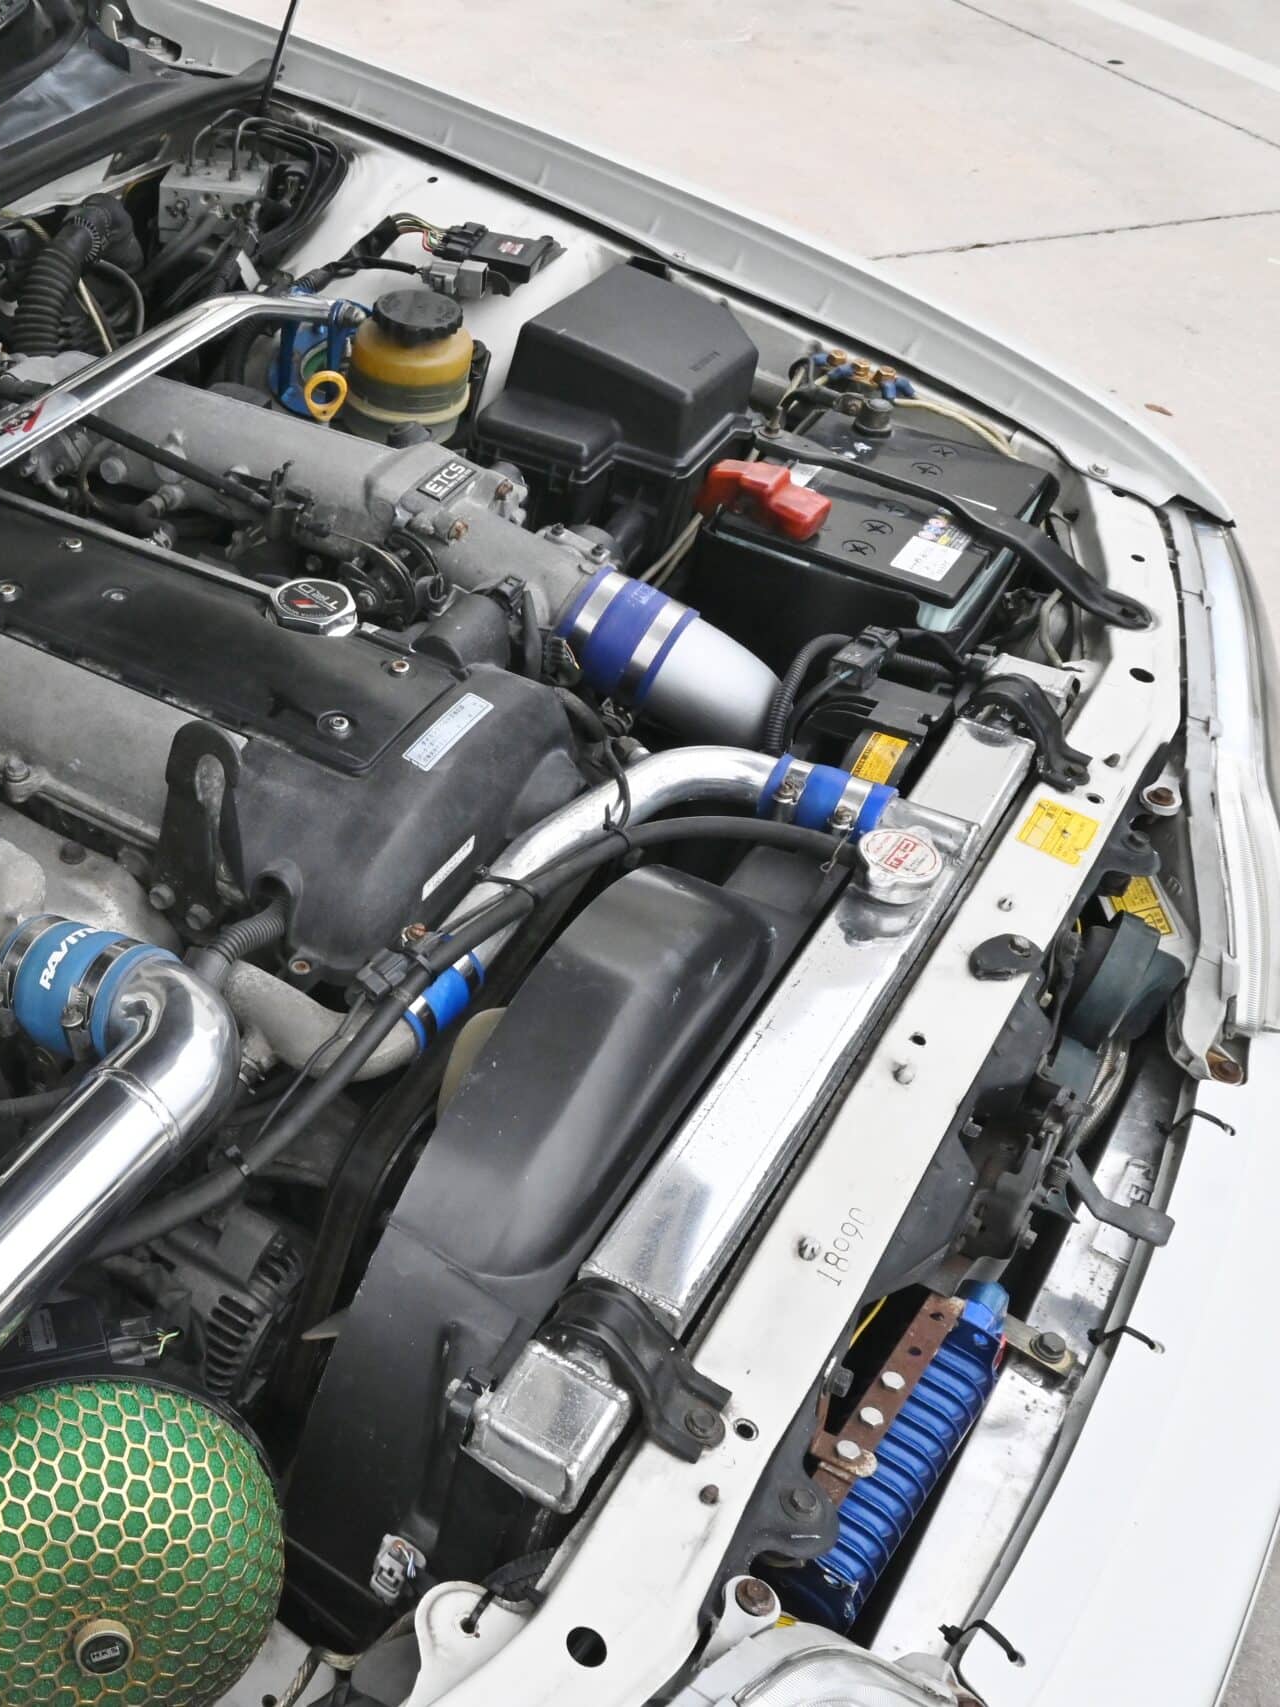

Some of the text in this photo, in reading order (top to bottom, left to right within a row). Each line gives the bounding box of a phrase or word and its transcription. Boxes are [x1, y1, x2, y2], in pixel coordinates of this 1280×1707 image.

[425, 462, 466, 493] ETCS
[298, 583, 339, 611] TRD
[90, 1645, 120, 1663] HKS
